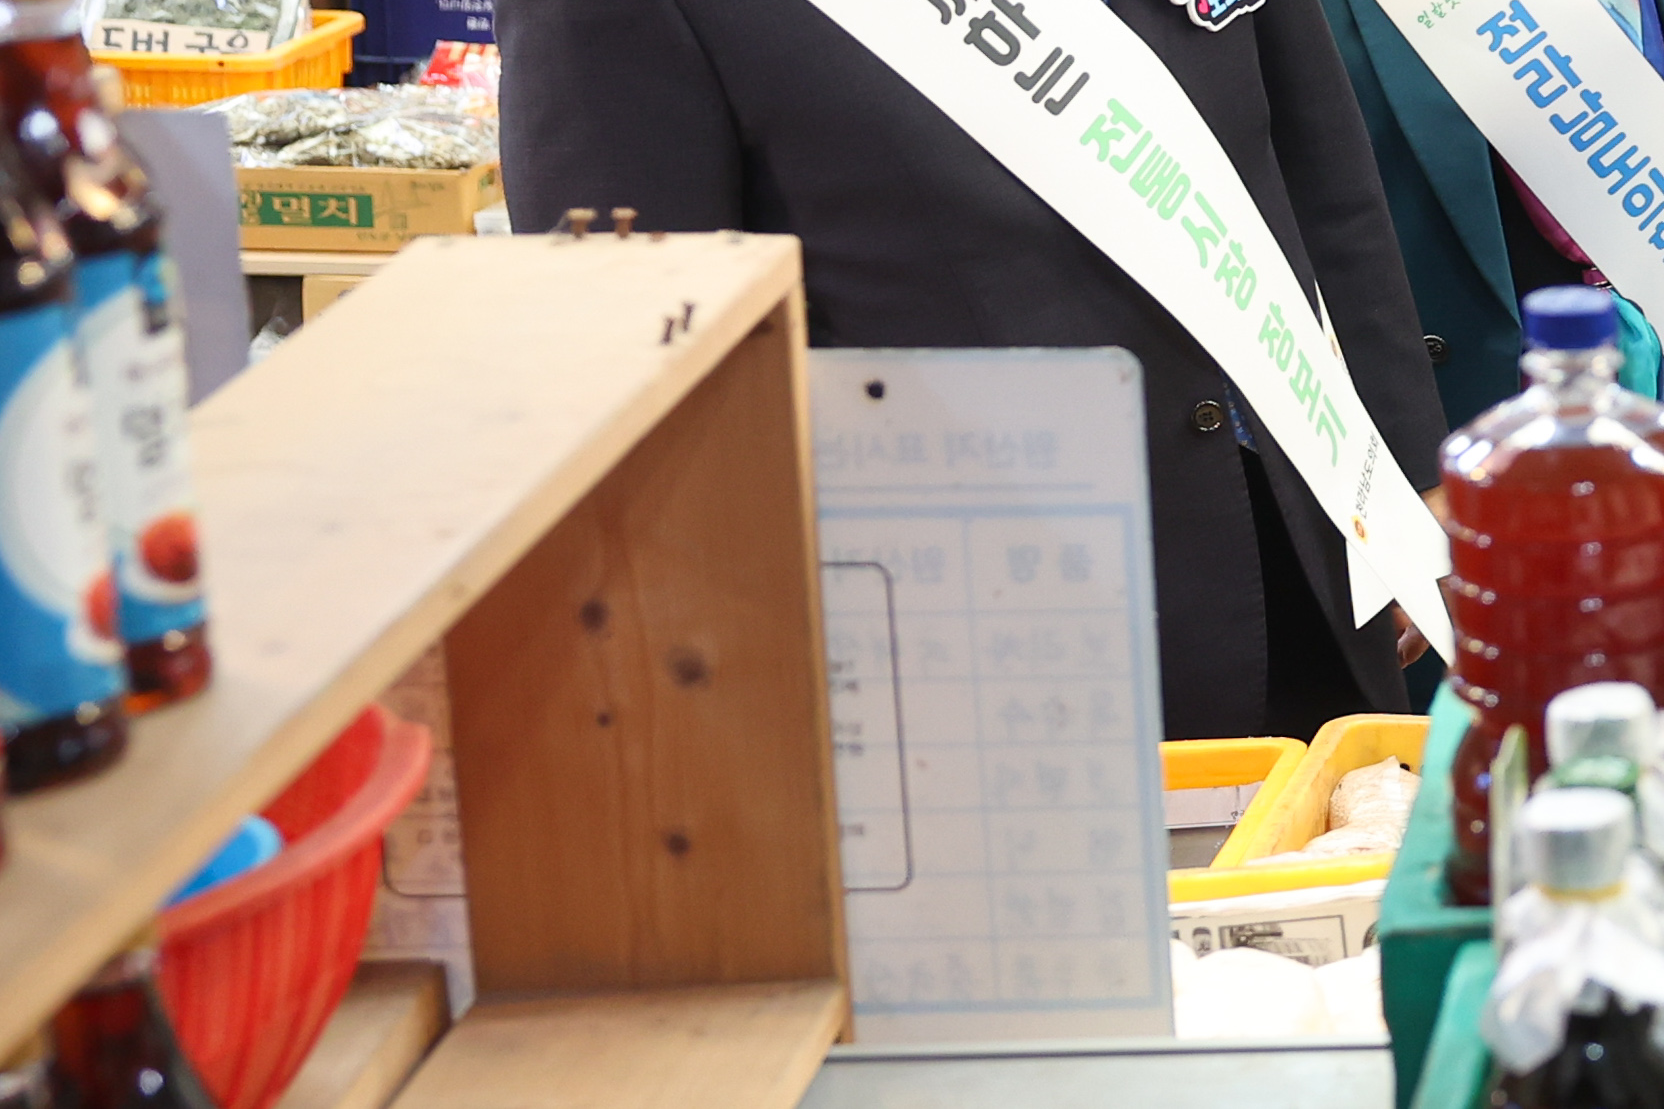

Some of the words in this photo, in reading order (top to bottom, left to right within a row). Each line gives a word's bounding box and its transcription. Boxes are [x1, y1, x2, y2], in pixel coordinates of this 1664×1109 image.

[1417, 10, 1434, 29] 일
[1431, 1, 1447, 18] 할
[271, 195, 360, 226] 멸치
[1080, 97, 1259, 312] 전통시장
[1259, 302, 1347, 468] 장보기
[1355, 435, 1380, 519] 전라남도의회
